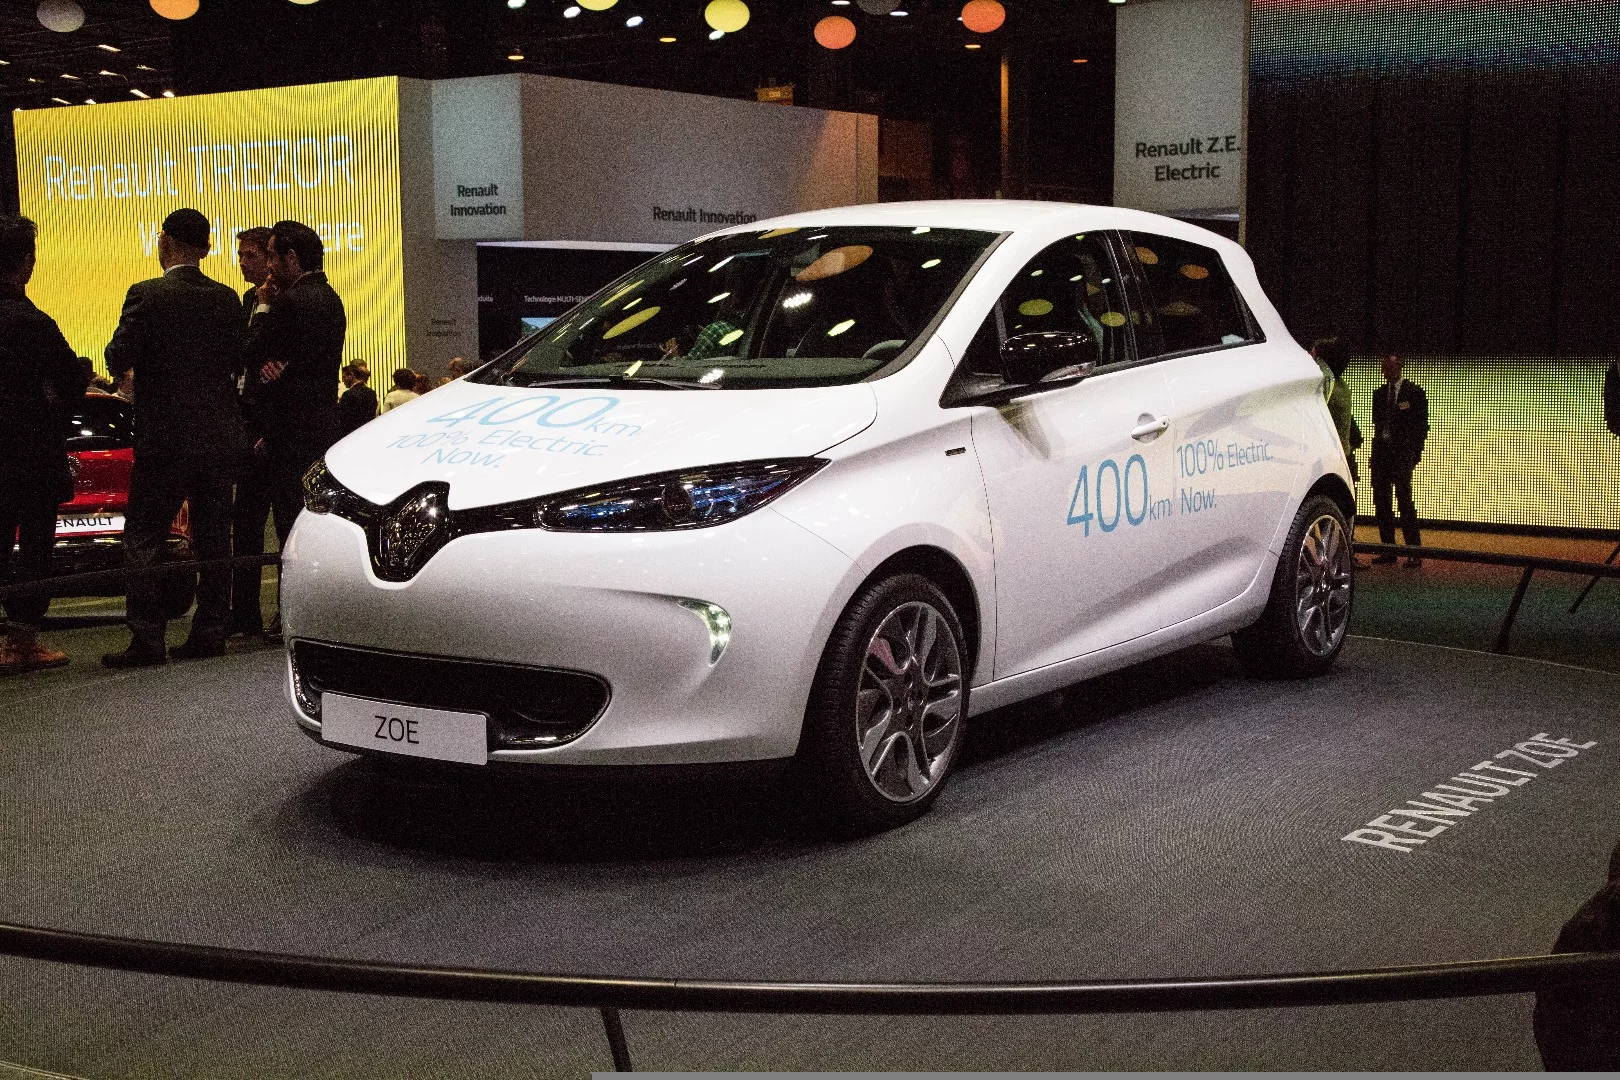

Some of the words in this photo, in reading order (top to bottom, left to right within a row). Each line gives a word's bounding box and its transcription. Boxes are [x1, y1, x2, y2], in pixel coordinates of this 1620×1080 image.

[1134, 138, 1203, 159] Renault
[1206, 135, 1241, 154] Z.E.
[44, 146, 179, 201] Renault
[187, 135, 355, 194] TREZOR
[1155, 162, 1221, 182] Electric
[456, 183, 499, 198] Renault
[449, 202, 507, 217] Innovation
[652, 206, 697, 223] Renault
[699, 208, 757, 225] Innovation
[426, 395, 620, 429] 400
[386, 430, 474, 450] 100%
[477, 429, 610, 457] Electric.
[419, 448, 507, 469] Now.
[1176, 438, 1224, 479] 100%
[1226, 439, 1274, 468] Electric.
[1066, 453, 1149, 538] 400
[1180, 486, 1218, 516] Now.
[55, 516, 114, 528] ENAULT
[374, 715, 420, 745] ZOE
[1340, 760, 1538, 853] RENAULT
[1493, 732, 1598, 769] ZOE
